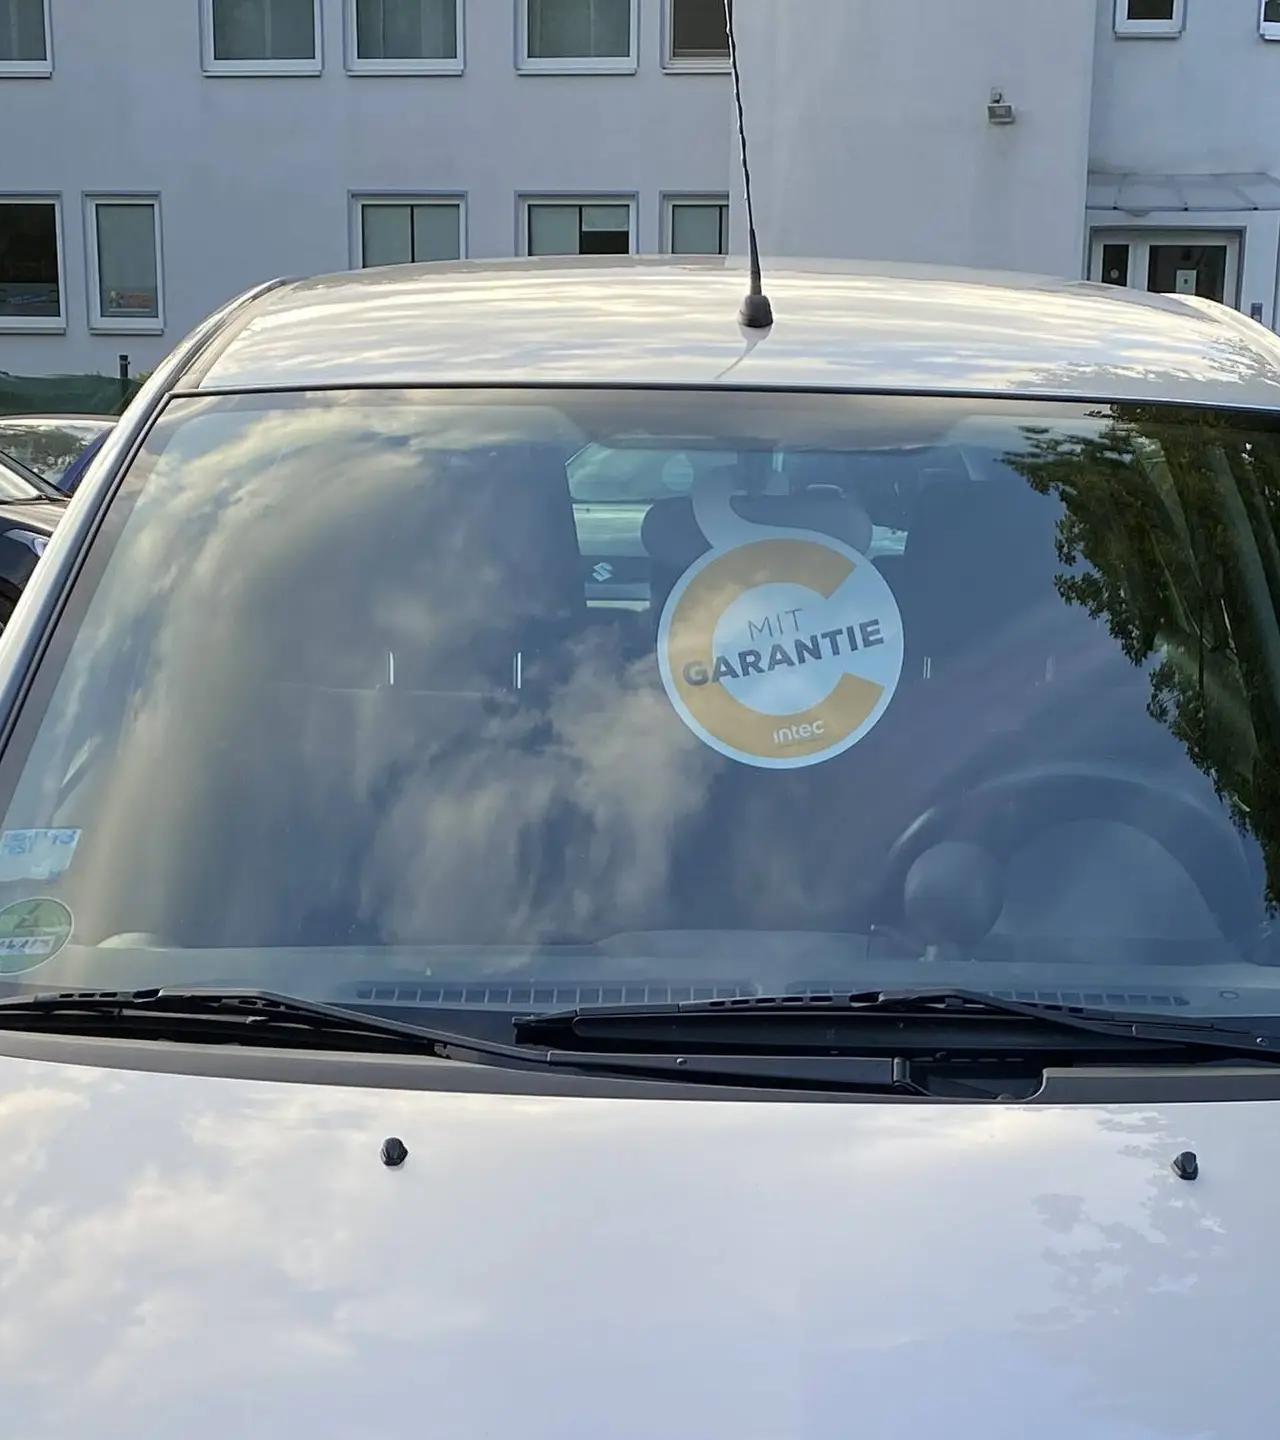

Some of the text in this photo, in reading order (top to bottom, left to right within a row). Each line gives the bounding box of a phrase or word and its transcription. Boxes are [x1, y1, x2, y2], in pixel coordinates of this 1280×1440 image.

[747, 607, 804, 642] MIT
[682, 618, 885, 687] GARANTIE
[773, 718, 825, 744] intec
